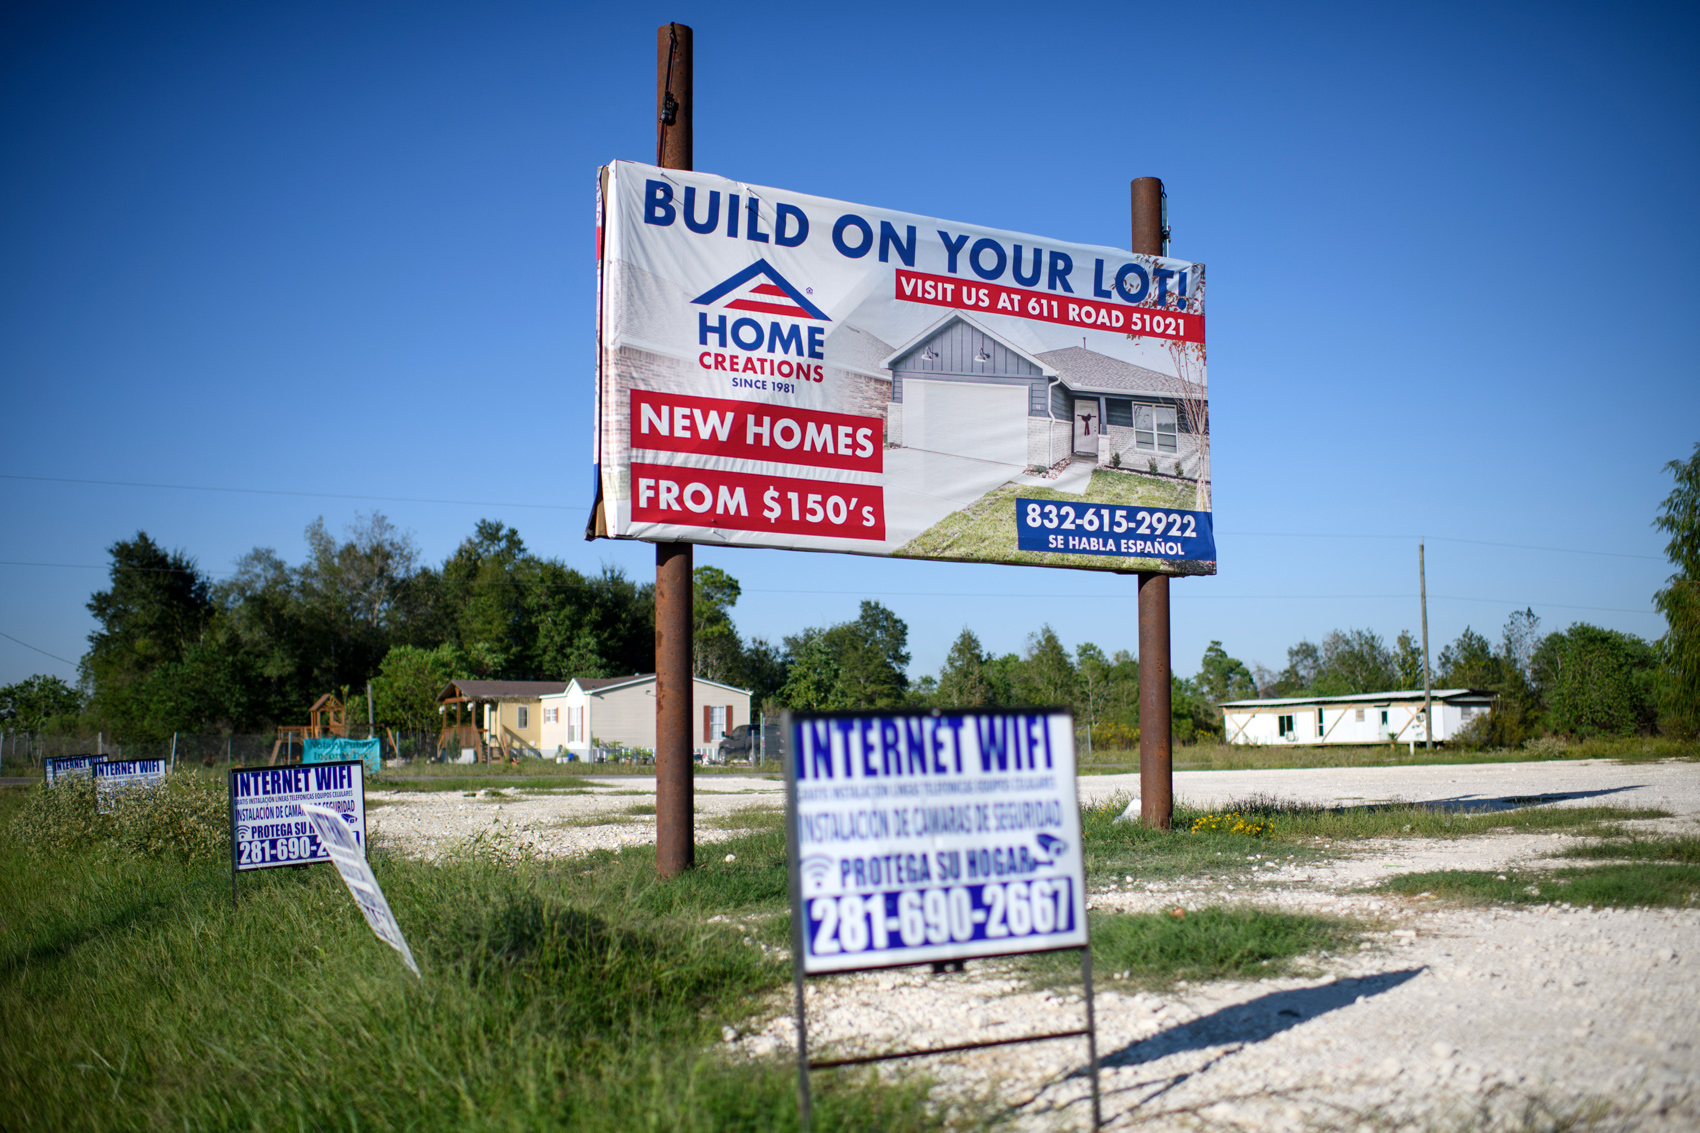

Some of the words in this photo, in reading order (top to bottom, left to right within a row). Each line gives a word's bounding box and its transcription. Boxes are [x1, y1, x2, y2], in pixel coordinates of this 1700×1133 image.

[643, 178, 810, 248] BUILD
[831, 213, 917, 268] ON
[936, 229, 1075, 294] YOUR
[1093, 257, 1188, 311] LOT!
[899, 276, 955, 302] VISIT
[961, 286, 990, 307] US
[996, 292, 1021, 312] AT
[1027, 297, 1059, 319] 611
[1068, 303, 1124, 329] ROAD
[1130, 312, 1185, 337] 51021
[698, 311, 825, 361] HOME
[698, 351, 824, 384] CREATIONS
[731, 376, 768, 391] SINCE
[771, 380, 795, 394] 1981
[640, 402, 735, 443] NEW
[745, 413, 874, 459] HOMES
[637, 477, 749, 518] FROM
[1026, 503, 1197, 539] 832-615-2922
[1048, 534, 1064, 549] SE
[1068, 536, 1117, 552] HABLA
[1120, 538, 1185, 556] ESPAÑOL
[796, 715, 965, 779] INTERNET
[975, 714, 1052, 773] WIFI
[94, 761, 138, 777] INTERNET
[139, 760, 160, 773] WIFI
[233, 768, 312, 797] INTERNET
[314, 766, 352, 791] WIFI
[275, 804, 284, 818] DE
[315, 791, 332, 800] EQUIPOS
[332, 790, 353, 799] CELULARES
[251, 822, 293, 839] PROTEGA
[294, 821, 307, 835] SU
[893, 808, 911, 838] DE
[975, 804, 991, 834] DE
[840, 852, 933, 889] PROTEGA
[936, 850, 962, 882] SU
[811, 878, 1071, 955] 281-690-2667
